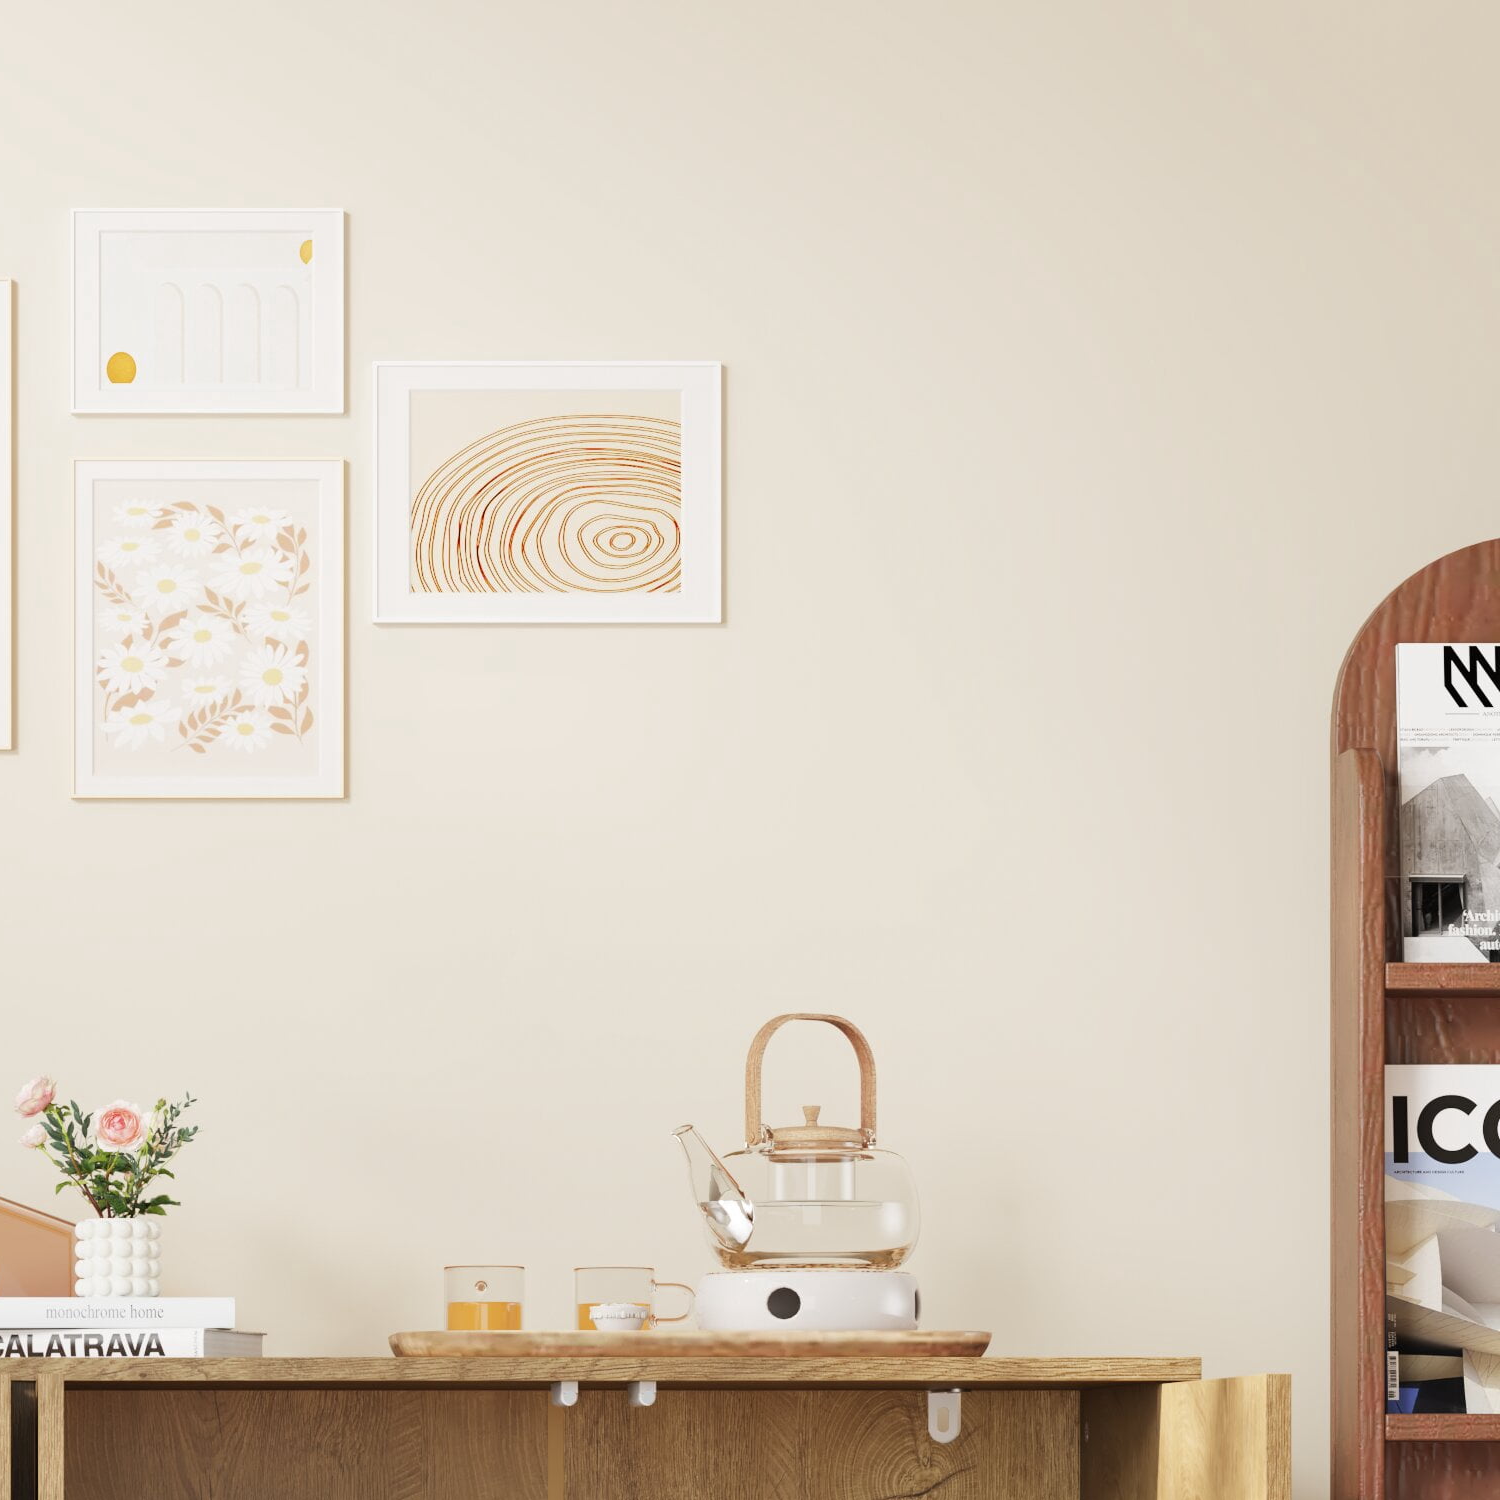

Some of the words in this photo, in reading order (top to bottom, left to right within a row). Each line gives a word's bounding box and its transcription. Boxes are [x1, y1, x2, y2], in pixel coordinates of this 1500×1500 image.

[1448, 924, 1497, 937] fashion.
[1393, 1095, 1500, 1164] IC
[46, 1305, 126, 1319] monochrome
[130, 1304, 164, 1319] home
